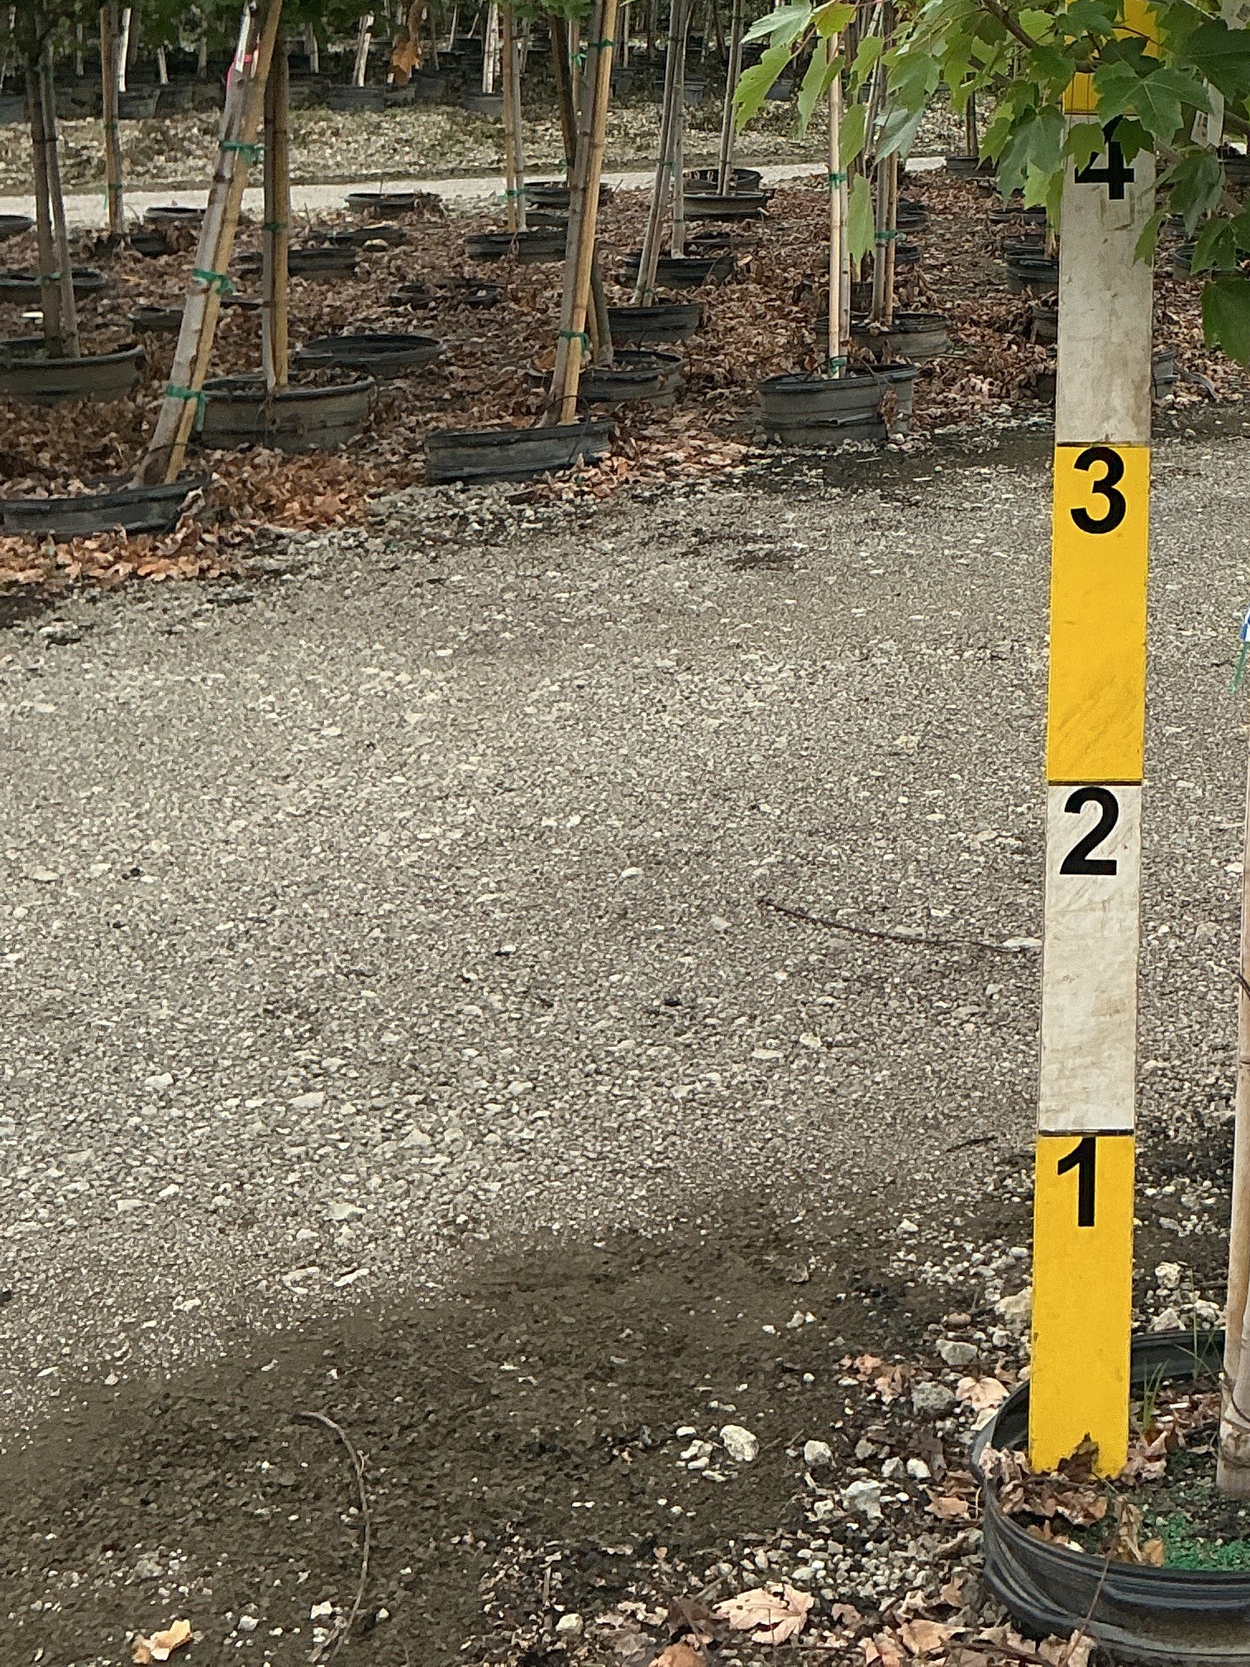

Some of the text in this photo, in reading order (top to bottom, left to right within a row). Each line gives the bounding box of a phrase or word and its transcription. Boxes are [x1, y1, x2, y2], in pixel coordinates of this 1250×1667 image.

[1075, 115, 1134, 200] 4
[1070, 446, 1126, 535] 3
[1059, 786, 1119, 876] 2
[1057, 1137, 1096, 1227] 1
